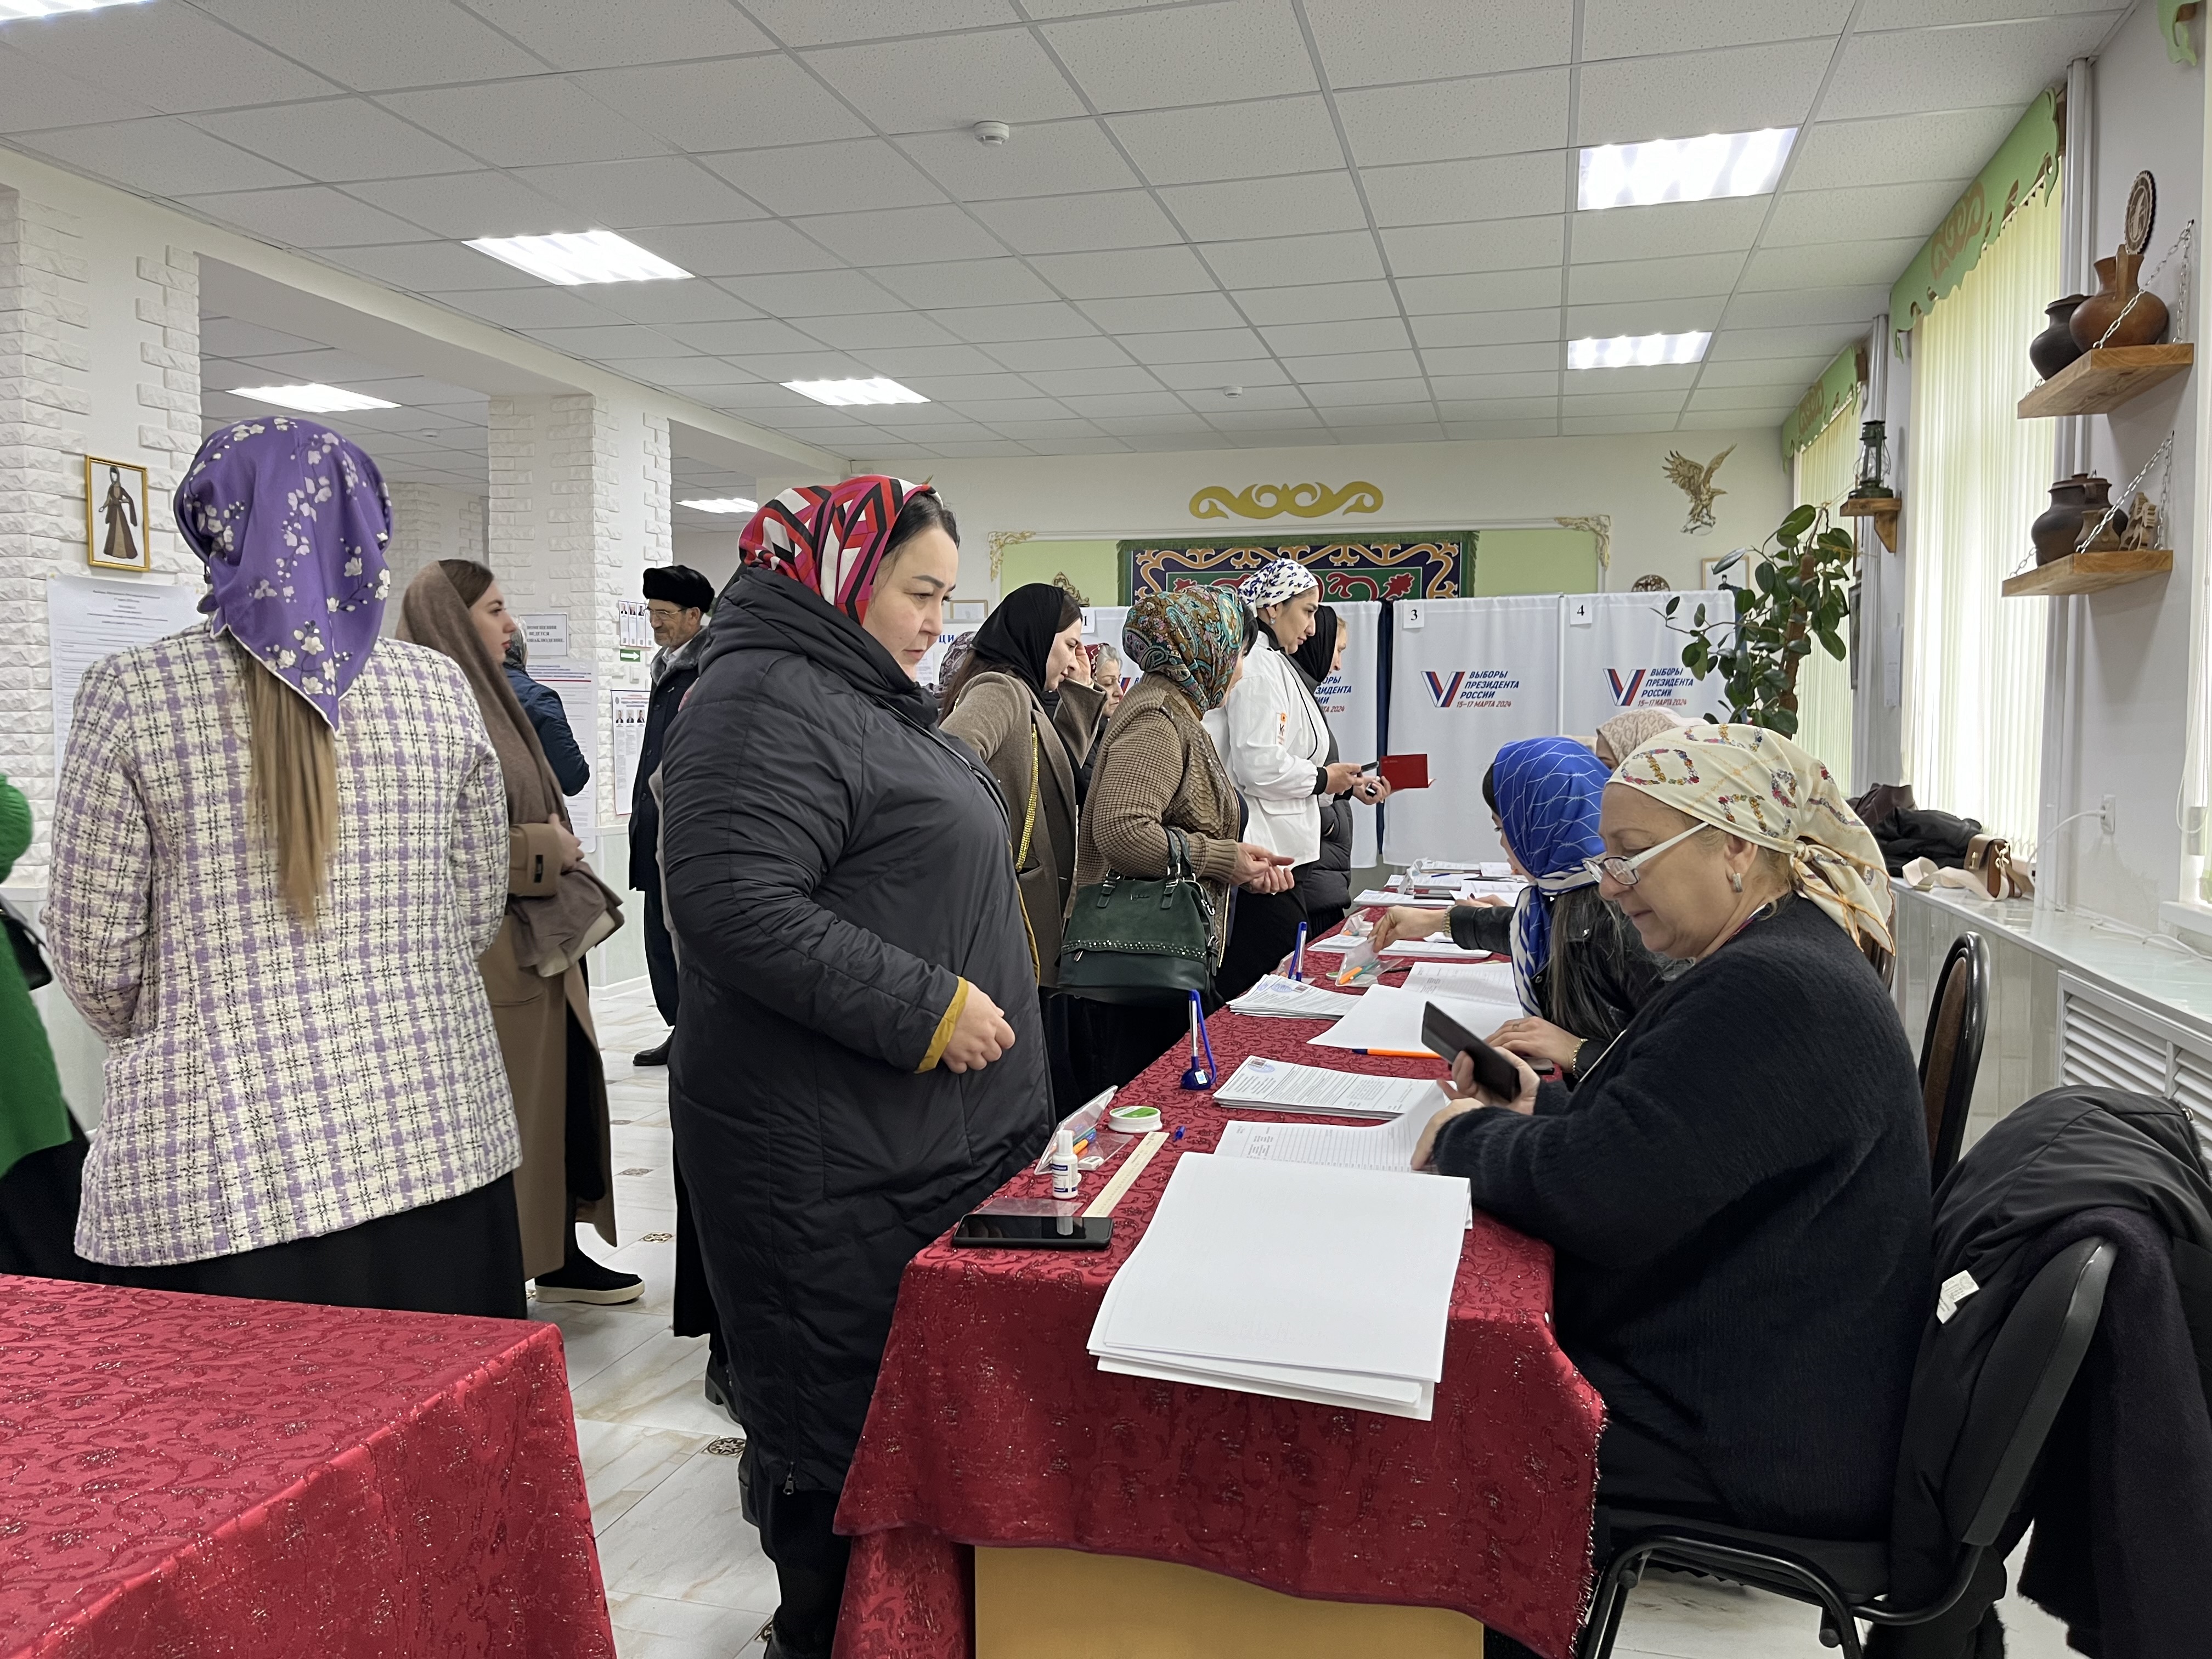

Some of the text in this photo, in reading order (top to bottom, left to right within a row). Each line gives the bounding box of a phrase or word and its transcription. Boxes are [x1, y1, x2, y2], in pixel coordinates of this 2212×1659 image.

[1410, 609, 1418, 621] 3
[1577, 604, 1585, 617] 4
[1469, 670, 1508, 679] ВЫБОРЫ
[1650, 667, 1684, 677] ВЫБОРЫ
[1322, 676, 1342, 685] ОРЫ
[1645, 678, 1694, 687] ПРЕЗИДЕНТА
[1315, 685, 1352, 695] ЗИДЕНТА
[1464, 681, 1520, 690] ПРЕЗИДЕНТА
[1460, 691, 1496, 699] РОССИИ
[1641, 689, 1672, 698] РОССИИ
